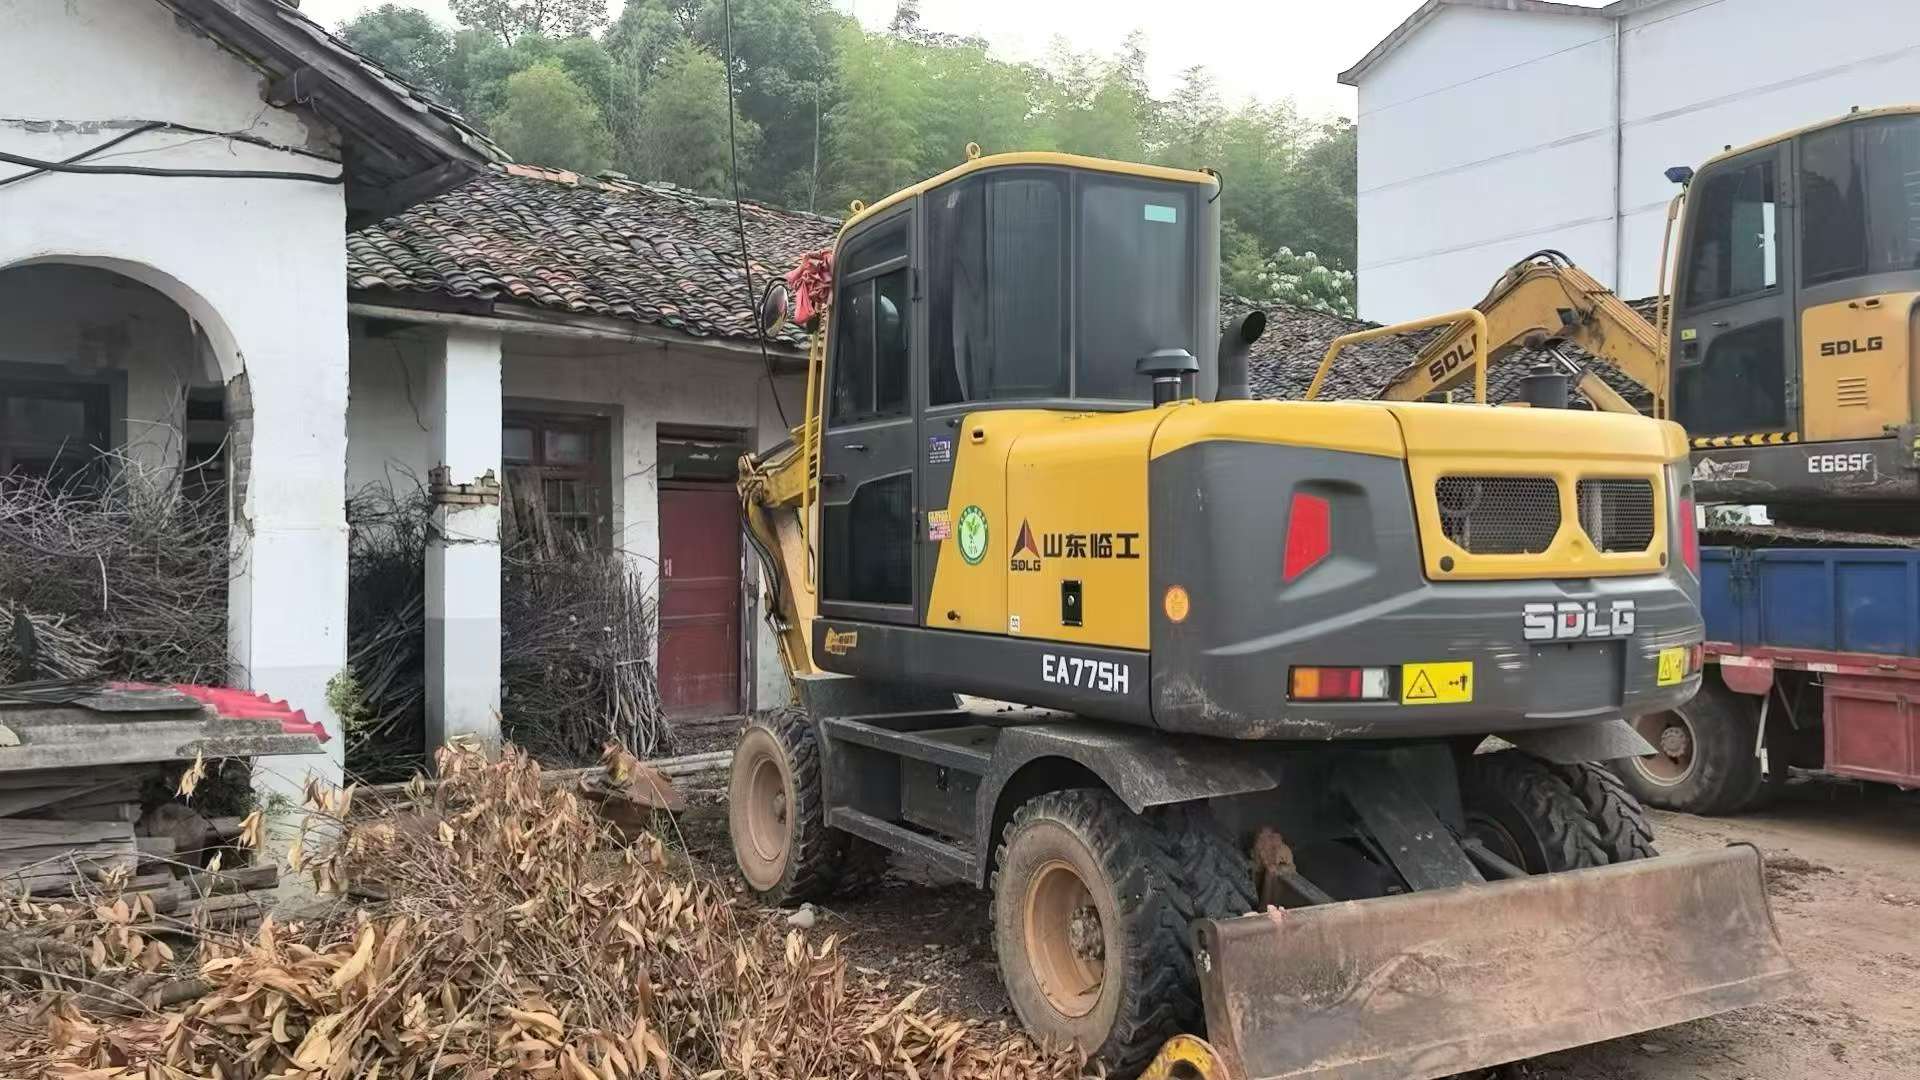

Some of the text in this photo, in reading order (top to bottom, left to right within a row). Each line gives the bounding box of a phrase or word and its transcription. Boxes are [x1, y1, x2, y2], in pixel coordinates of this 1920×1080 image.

[1429, 333, 1478, 383] SDL
[1821, 336, 1882, 356] SDLG
[1043, 533, 1140, 559] 山东临工
[1010, 560, 1041, 571] SDLG
[1523, 600, 1636, 640] SDLG
[1042, 654, 1129, 694] EA775H
